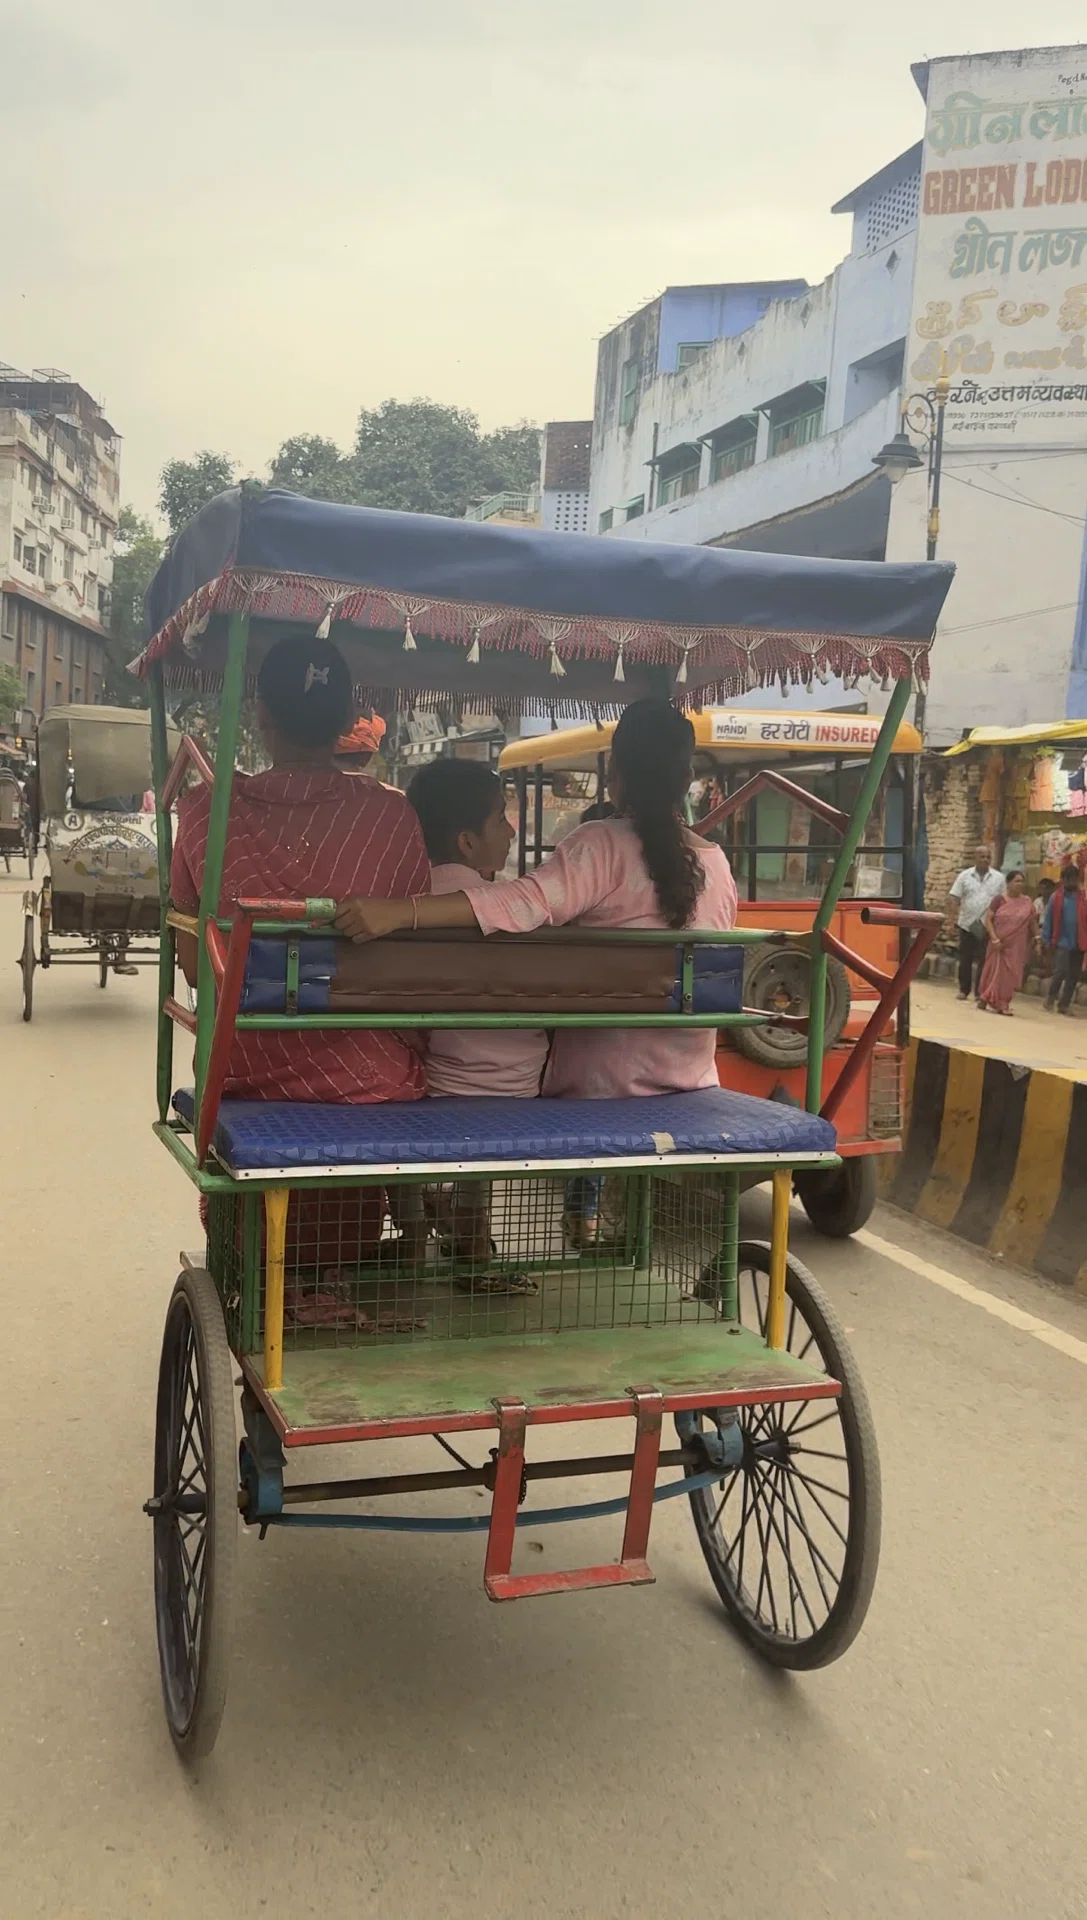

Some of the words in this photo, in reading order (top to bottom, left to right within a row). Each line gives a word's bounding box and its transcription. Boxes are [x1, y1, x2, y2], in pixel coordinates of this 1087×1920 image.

[1029, 96, 1087, 142] ला
[923, 163, 1018, 216] GREEN
[989, 384, 1033, 402] उत्तम
[716, 724, 747, 735] NANDI
[760, 722, 781, 740] हर
[782, 720, 811, 741] रोटी
[815, 724, 879, 743] INSURED
